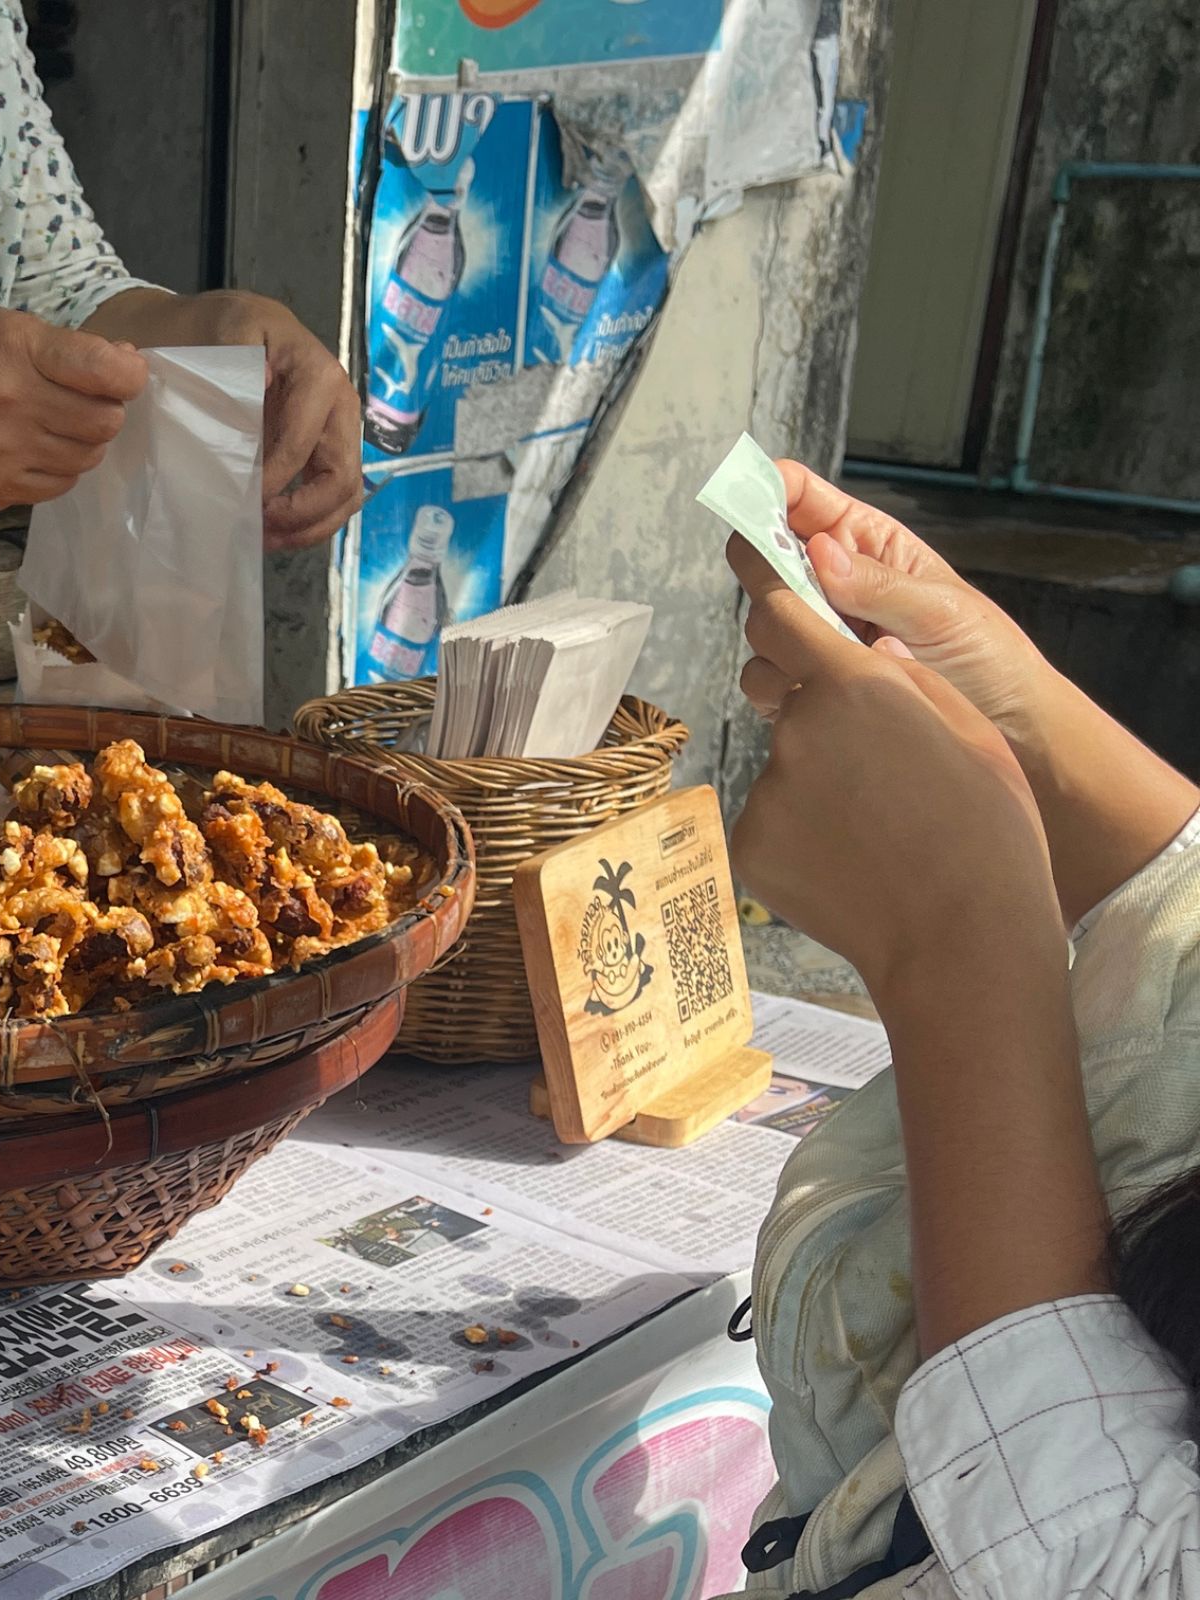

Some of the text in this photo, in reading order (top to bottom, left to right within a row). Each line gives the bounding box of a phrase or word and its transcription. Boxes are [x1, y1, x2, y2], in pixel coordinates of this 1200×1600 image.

[82, 1365, 137, 1392] 원재료
[63, 1433, 141, 1473] 49,800원
[39, 1502, 72, 1520] 구입시
[88, 1473, 202, 1532] 1800-6639
